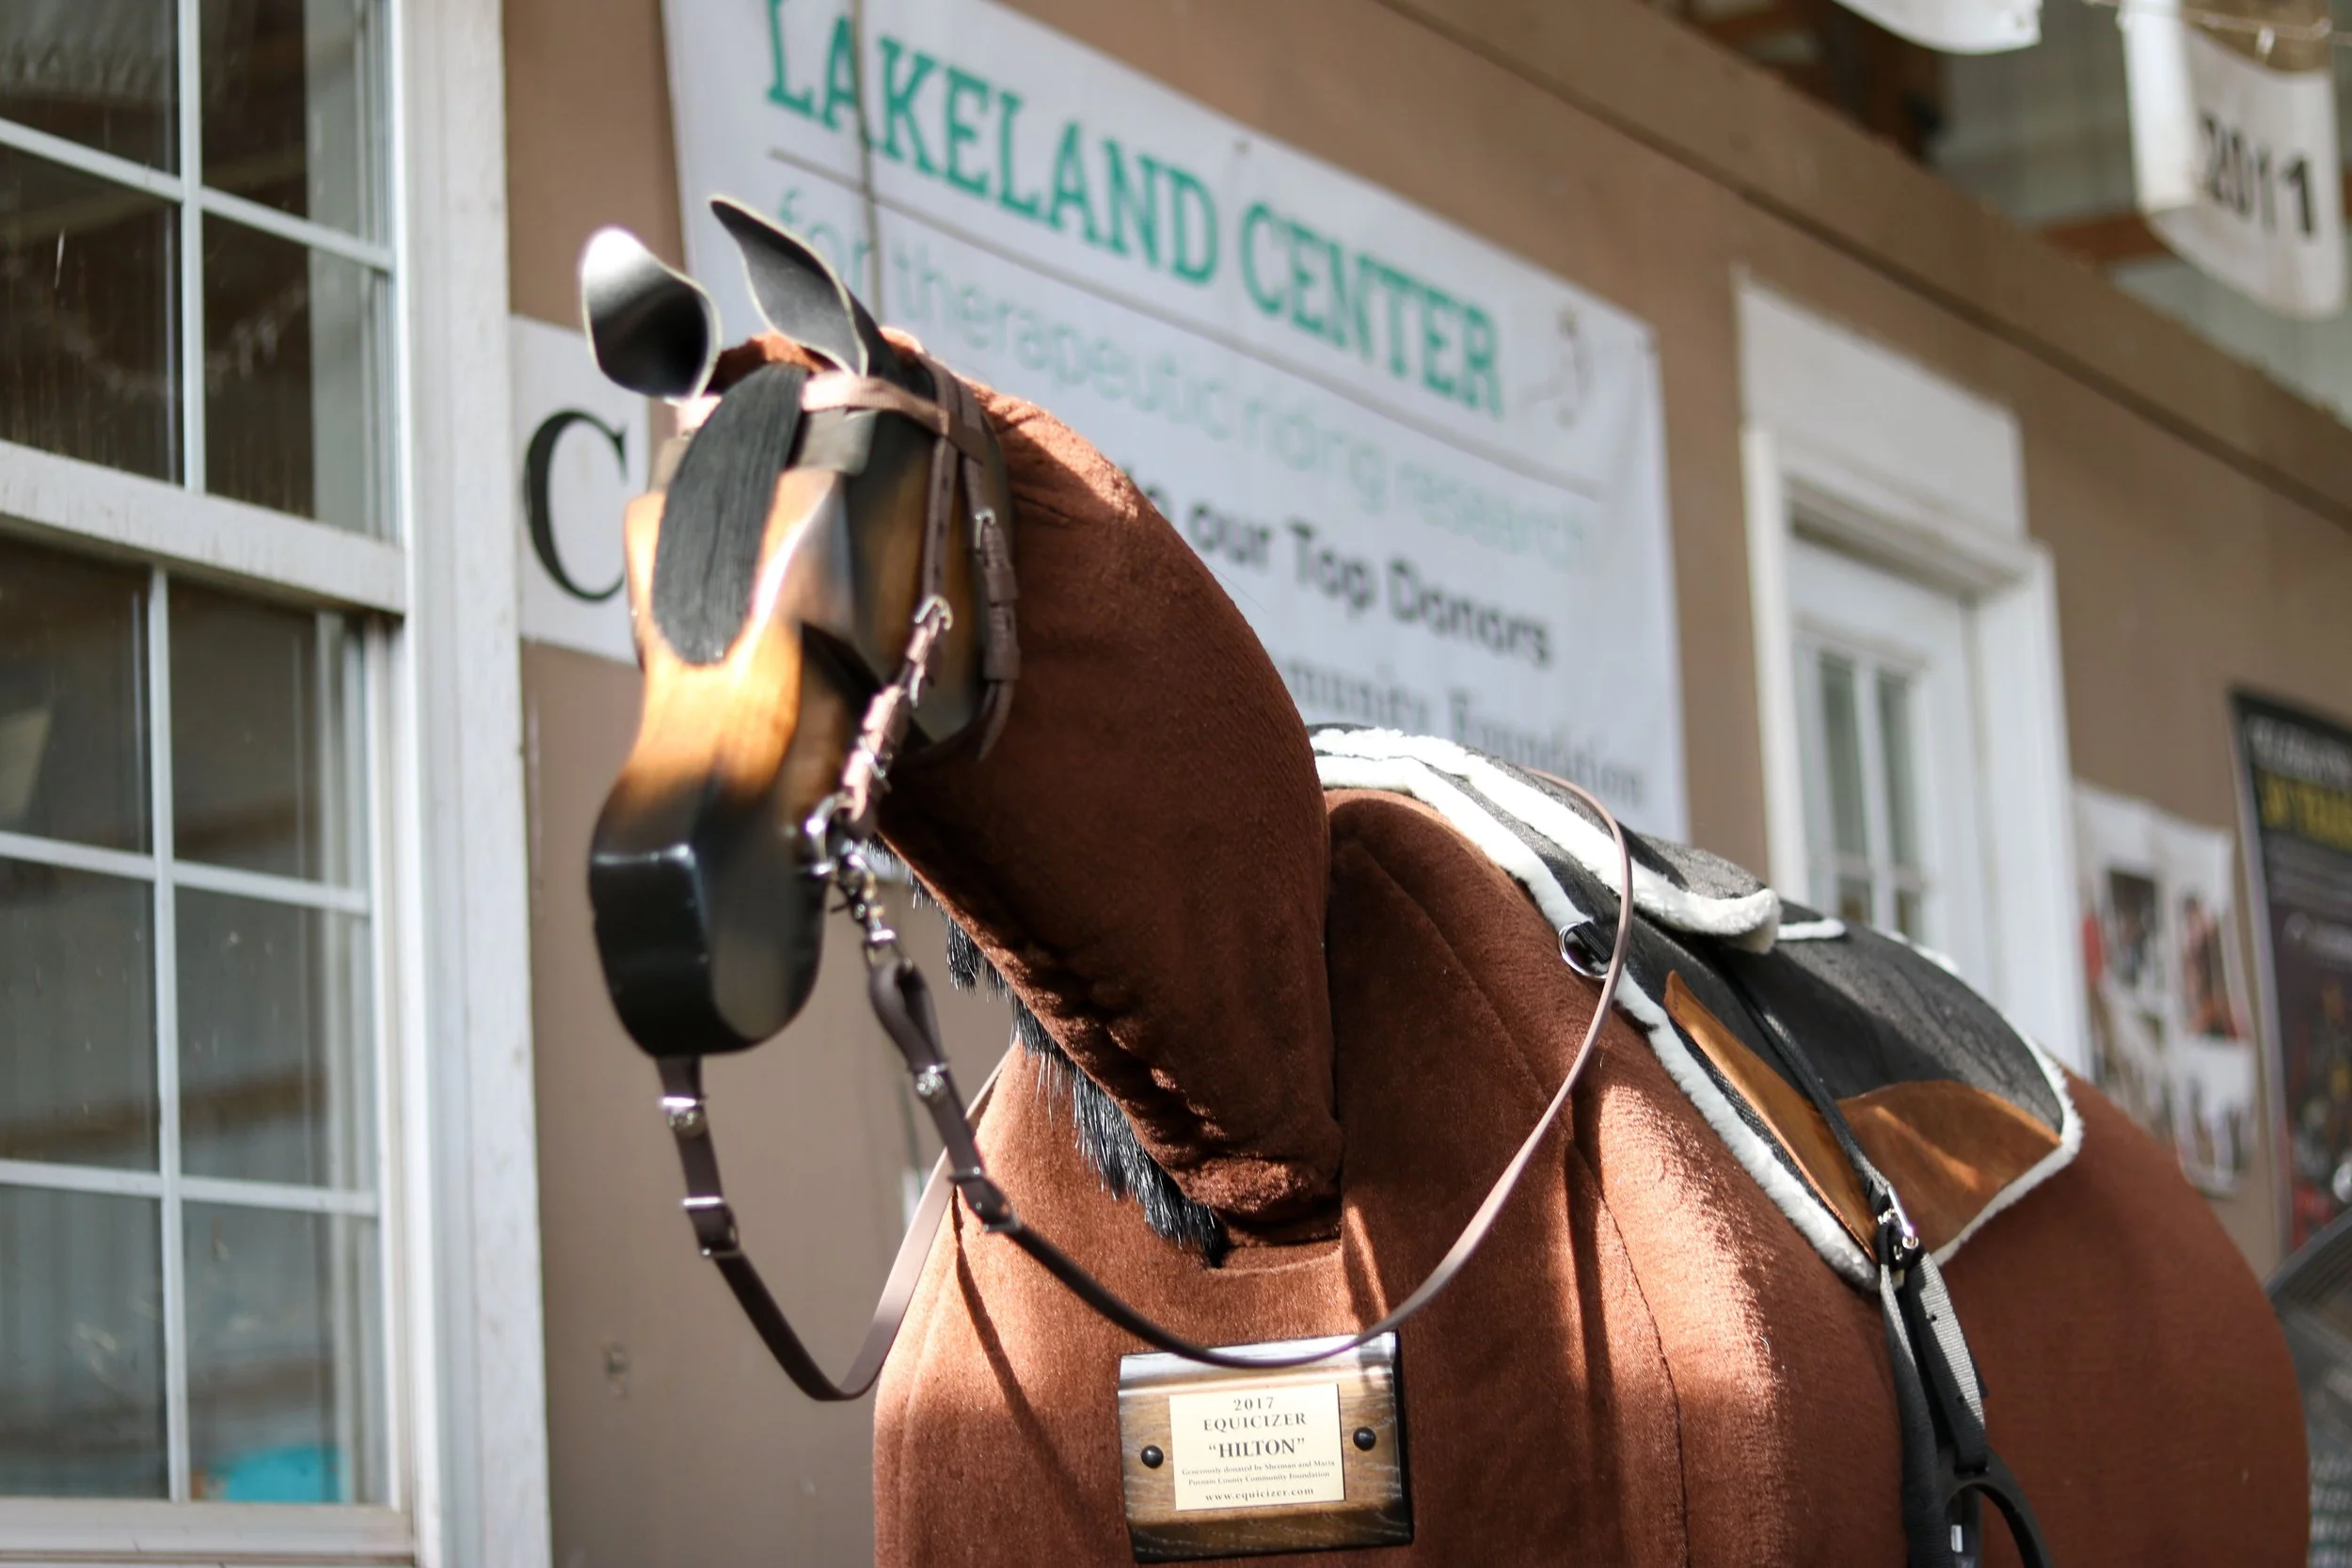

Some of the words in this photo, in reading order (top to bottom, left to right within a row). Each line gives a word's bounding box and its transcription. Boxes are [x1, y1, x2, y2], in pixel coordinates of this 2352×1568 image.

[2200, 110, 2316, 240] 2011
[766, 0, 1219, 286] LAKELAND
[1238, 200, 1504, 422] CENTER
[892, 228, 1232, 441] therapeutic
[1186, 500, 1272, 568] our
[1288, 515, 1375, 615] Top
[1388, 558, 1554, 668] Donors
[1233, 1396, 1275, 1411] 2017
[1202, 1412, 1308, 1433] EQUICIZER
[1223, 1464, 1252, 1474] donated
[1298, 1461, 1312, 1469] and
[1289, 1470, 1330, 1481] Foundation
[1205, 1486, 1314, 1502] www.equicizer.com
